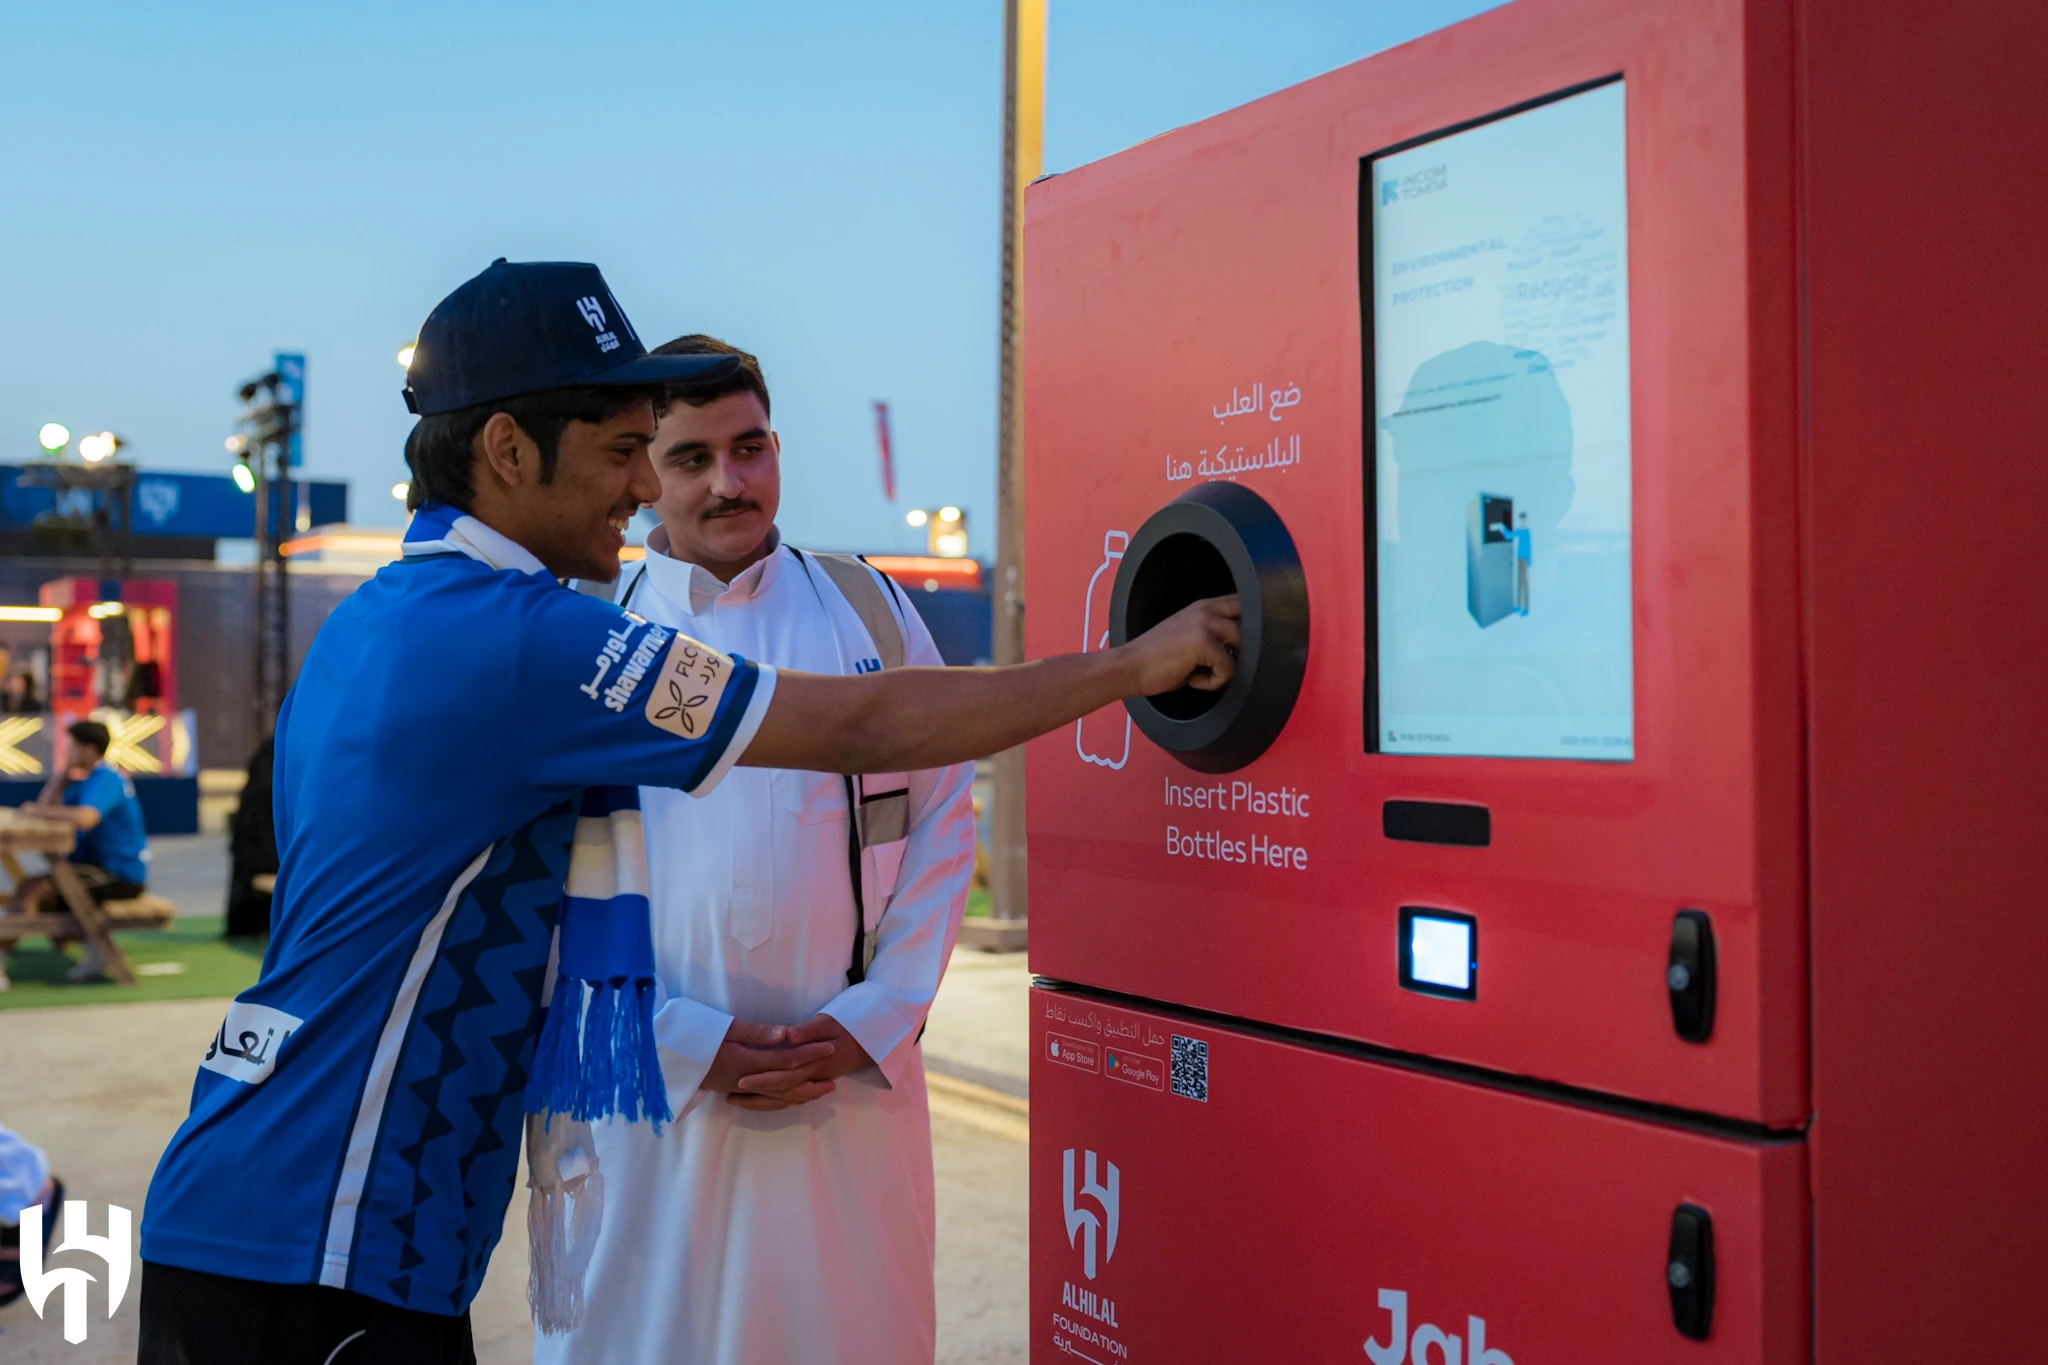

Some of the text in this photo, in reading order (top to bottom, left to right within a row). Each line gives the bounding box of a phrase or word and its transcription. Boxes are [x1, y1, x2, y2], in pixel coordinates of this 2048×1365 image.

[1212, 381, 1302, 425] ضع العلب
[1166, 434, 1301, 482] البلاستيكية هنا
[1165, 776, 1310, 817] Insert Plastic
[1166, 825, 1308, 871] Bottles Here
[1045, 1001, 1165, 1047] حمل التطبيق واكسب نقاط
[1062, 1048, 1095, 1066] App Store
[1121, 1063, 1160, 1085] Google Play
[1062, 1281, 1119, 1329] ALHILAL
[1053, 1312, 1128, 1360] FOUNDATION
